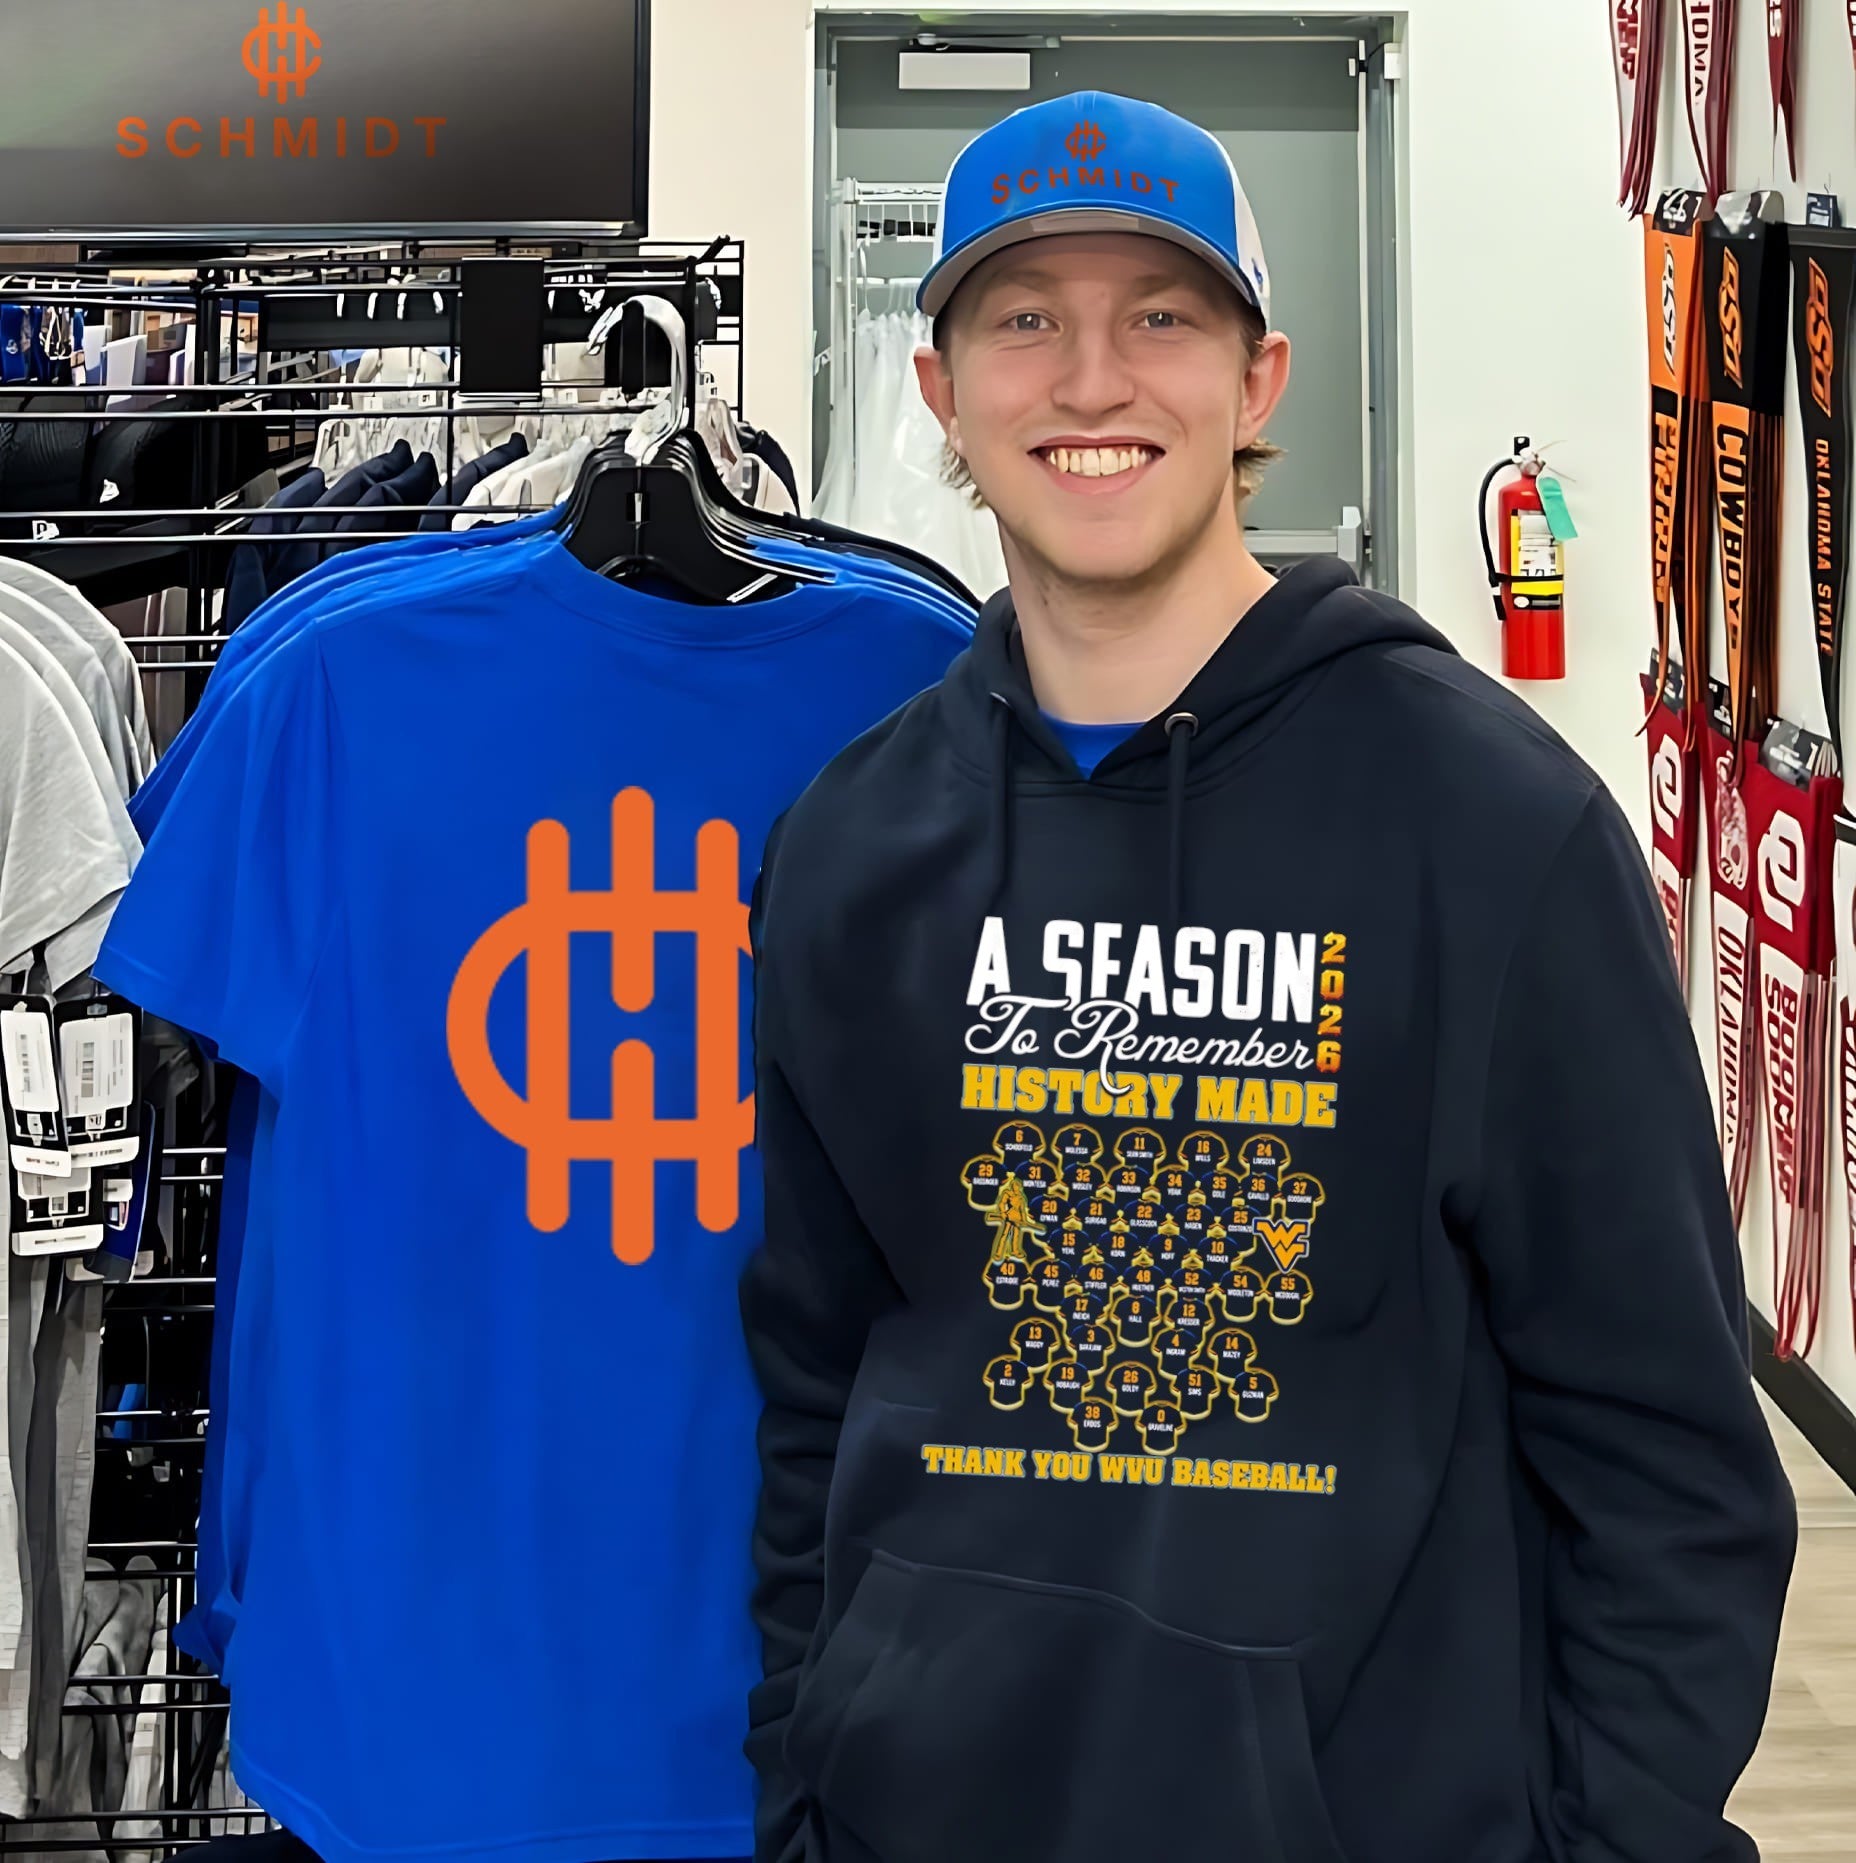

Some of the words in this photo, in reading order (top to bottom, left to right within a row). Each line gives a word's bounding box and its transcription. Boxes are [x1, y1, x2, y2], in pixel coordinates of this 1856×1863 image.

[115, 116, 447, 159] SCHMIDT
[992, 167, 1179, 204] SCHMIDT
[1816, 438, 1832, 570] OKLAHOMA
[1817, 583, 1833, 656] STATE
[966, 916, 1011, 1006] A
[1042, 919, 1317, 1023] SEASON
[1317, 931, 1347, 1073] 2026
[964, 994, 1071, 1055] To
[1054, 999, 1315, 1095] Remember
[961, 1063, 1184, 1120] HISTORY
[1195, 1075, 1339, 1129] MADE
[1015, 1130, 1024, 1143] 6
[1073, 1133, 1081, 1146] 7
[1134, 1137, 1145, 1150] 11
[1256, 1143, 1272, 1157] 24
[978, 1164, 994, 1177] 29
[1028, 1166, 1042, 1180] 31
[1076, 1169, 1091, 1182] 32
[1122, 1171, 1136, 1185] 33
[1168, 1173, 1182, 1187] 34
[1212, 1176, 1227, 1189] 35
[1251, 1178, 1266, 1191] 36
[1292, 1181, 1308, 1195] 37
[1042, 1200, 1057, 1213] 20
[1090, 1202, 1103, 1216] 21
[1137, 1205, 1153, 1219] 22
[1186, 1208, 1201, 1221] 23
[1233, 1211, 1248, 1224] 25
[1062, 1233, 1076, 1246] 15
[1112, 1235, 1125, 1249] 18
[1164, 1238, 1172, 1252] 9
[1211, 1241, 1225, 1254] 10
[1000, 1262, 1015, 1276] 40
[1043, 1265, 1059, 1278] 45
[1089, 1267, 1104, 1280] 46
[1136, 1269, 1152, 1283] 48
[1185, 1272, 1199, 1286] 52
[1233, 1275, 1248, 1288] 54
[1281, 1277, 1296, 1291] 55
[1075, 1298, 1089, 1312] 17
[1182, 1303, 1196, 1317] 12
[1028, 1326, 1042, 1340] 13
[1087, 1329, 1095, 1343] 3
[1171, 1334, 1180, 1347] 4
[1225, 1337, 1239, 1350] 14
[1004, 1363, 1012, 1377] 2
[1061, 1366, 1075, 1380] 19
[1123, 1370, 1139, 1384] 26
[1188, 1373, 1202, 1387] 51
[1249, 1376, 1258, 1390] 5
[1085, 1405, 1100, 1419] 38
[1157, 1409, 1165, 1423] 0
[922, 1444, 1026, 1478] THANK
[1033, 1450, 1092, 1482] YOU
[1099, 1455, 1165, 1486] WVU
[1171, 1458, 1338, 1495] BASEBALL!
